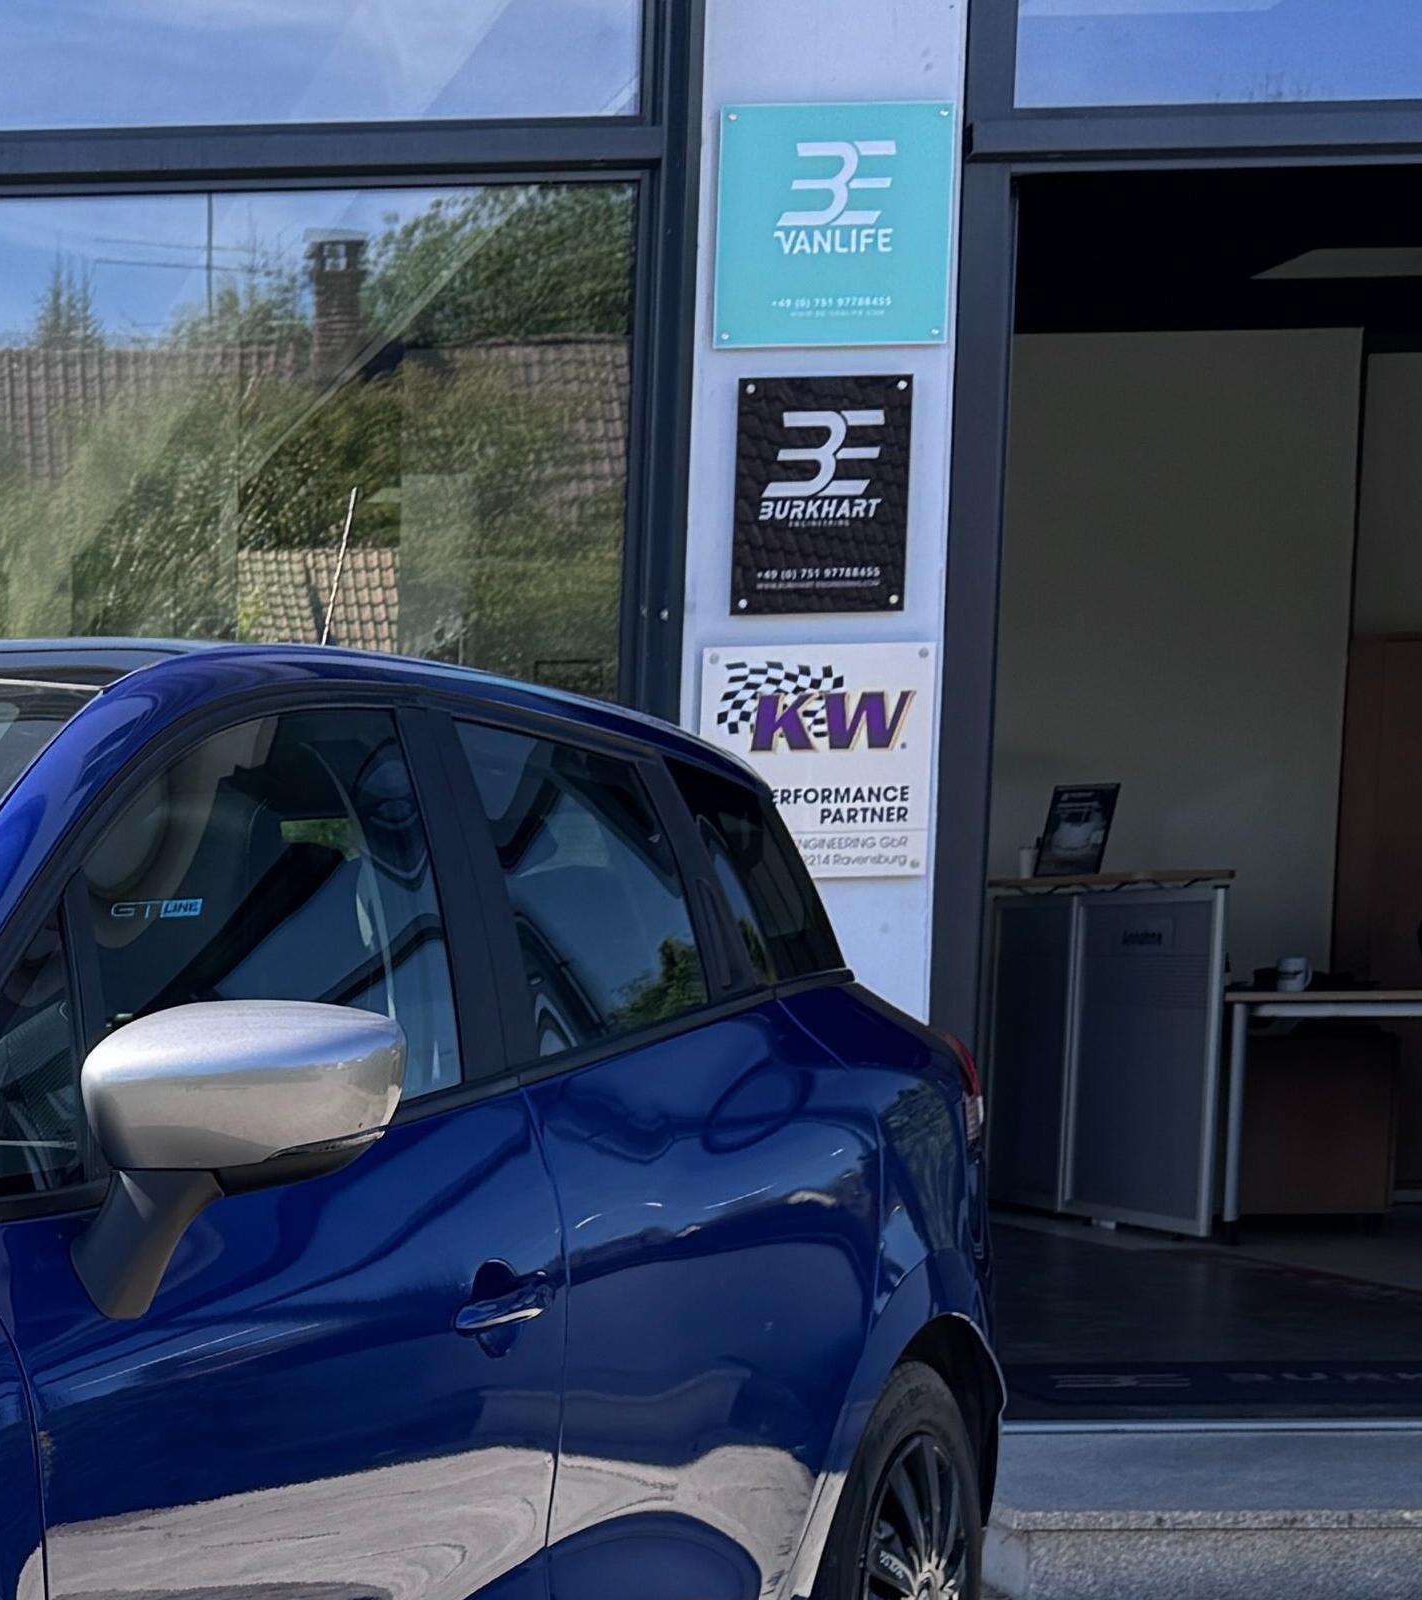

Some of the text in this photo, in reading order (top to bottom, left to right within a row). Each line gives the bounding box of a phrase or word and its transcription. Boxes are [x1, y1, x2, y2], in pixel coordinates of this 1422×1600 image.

[773, 228, 893, 255] VANLIFE
[758, 498, 882, 521] BURKHART
[750, 689, 916, 752] KW
[772, 785, 910, 805] ERFORMANCE
[819, 806, 909, 825] PARTNER
[797, 835, 876, 850] NGINEERING
[833, 853, 907, 868] Ravensburg
